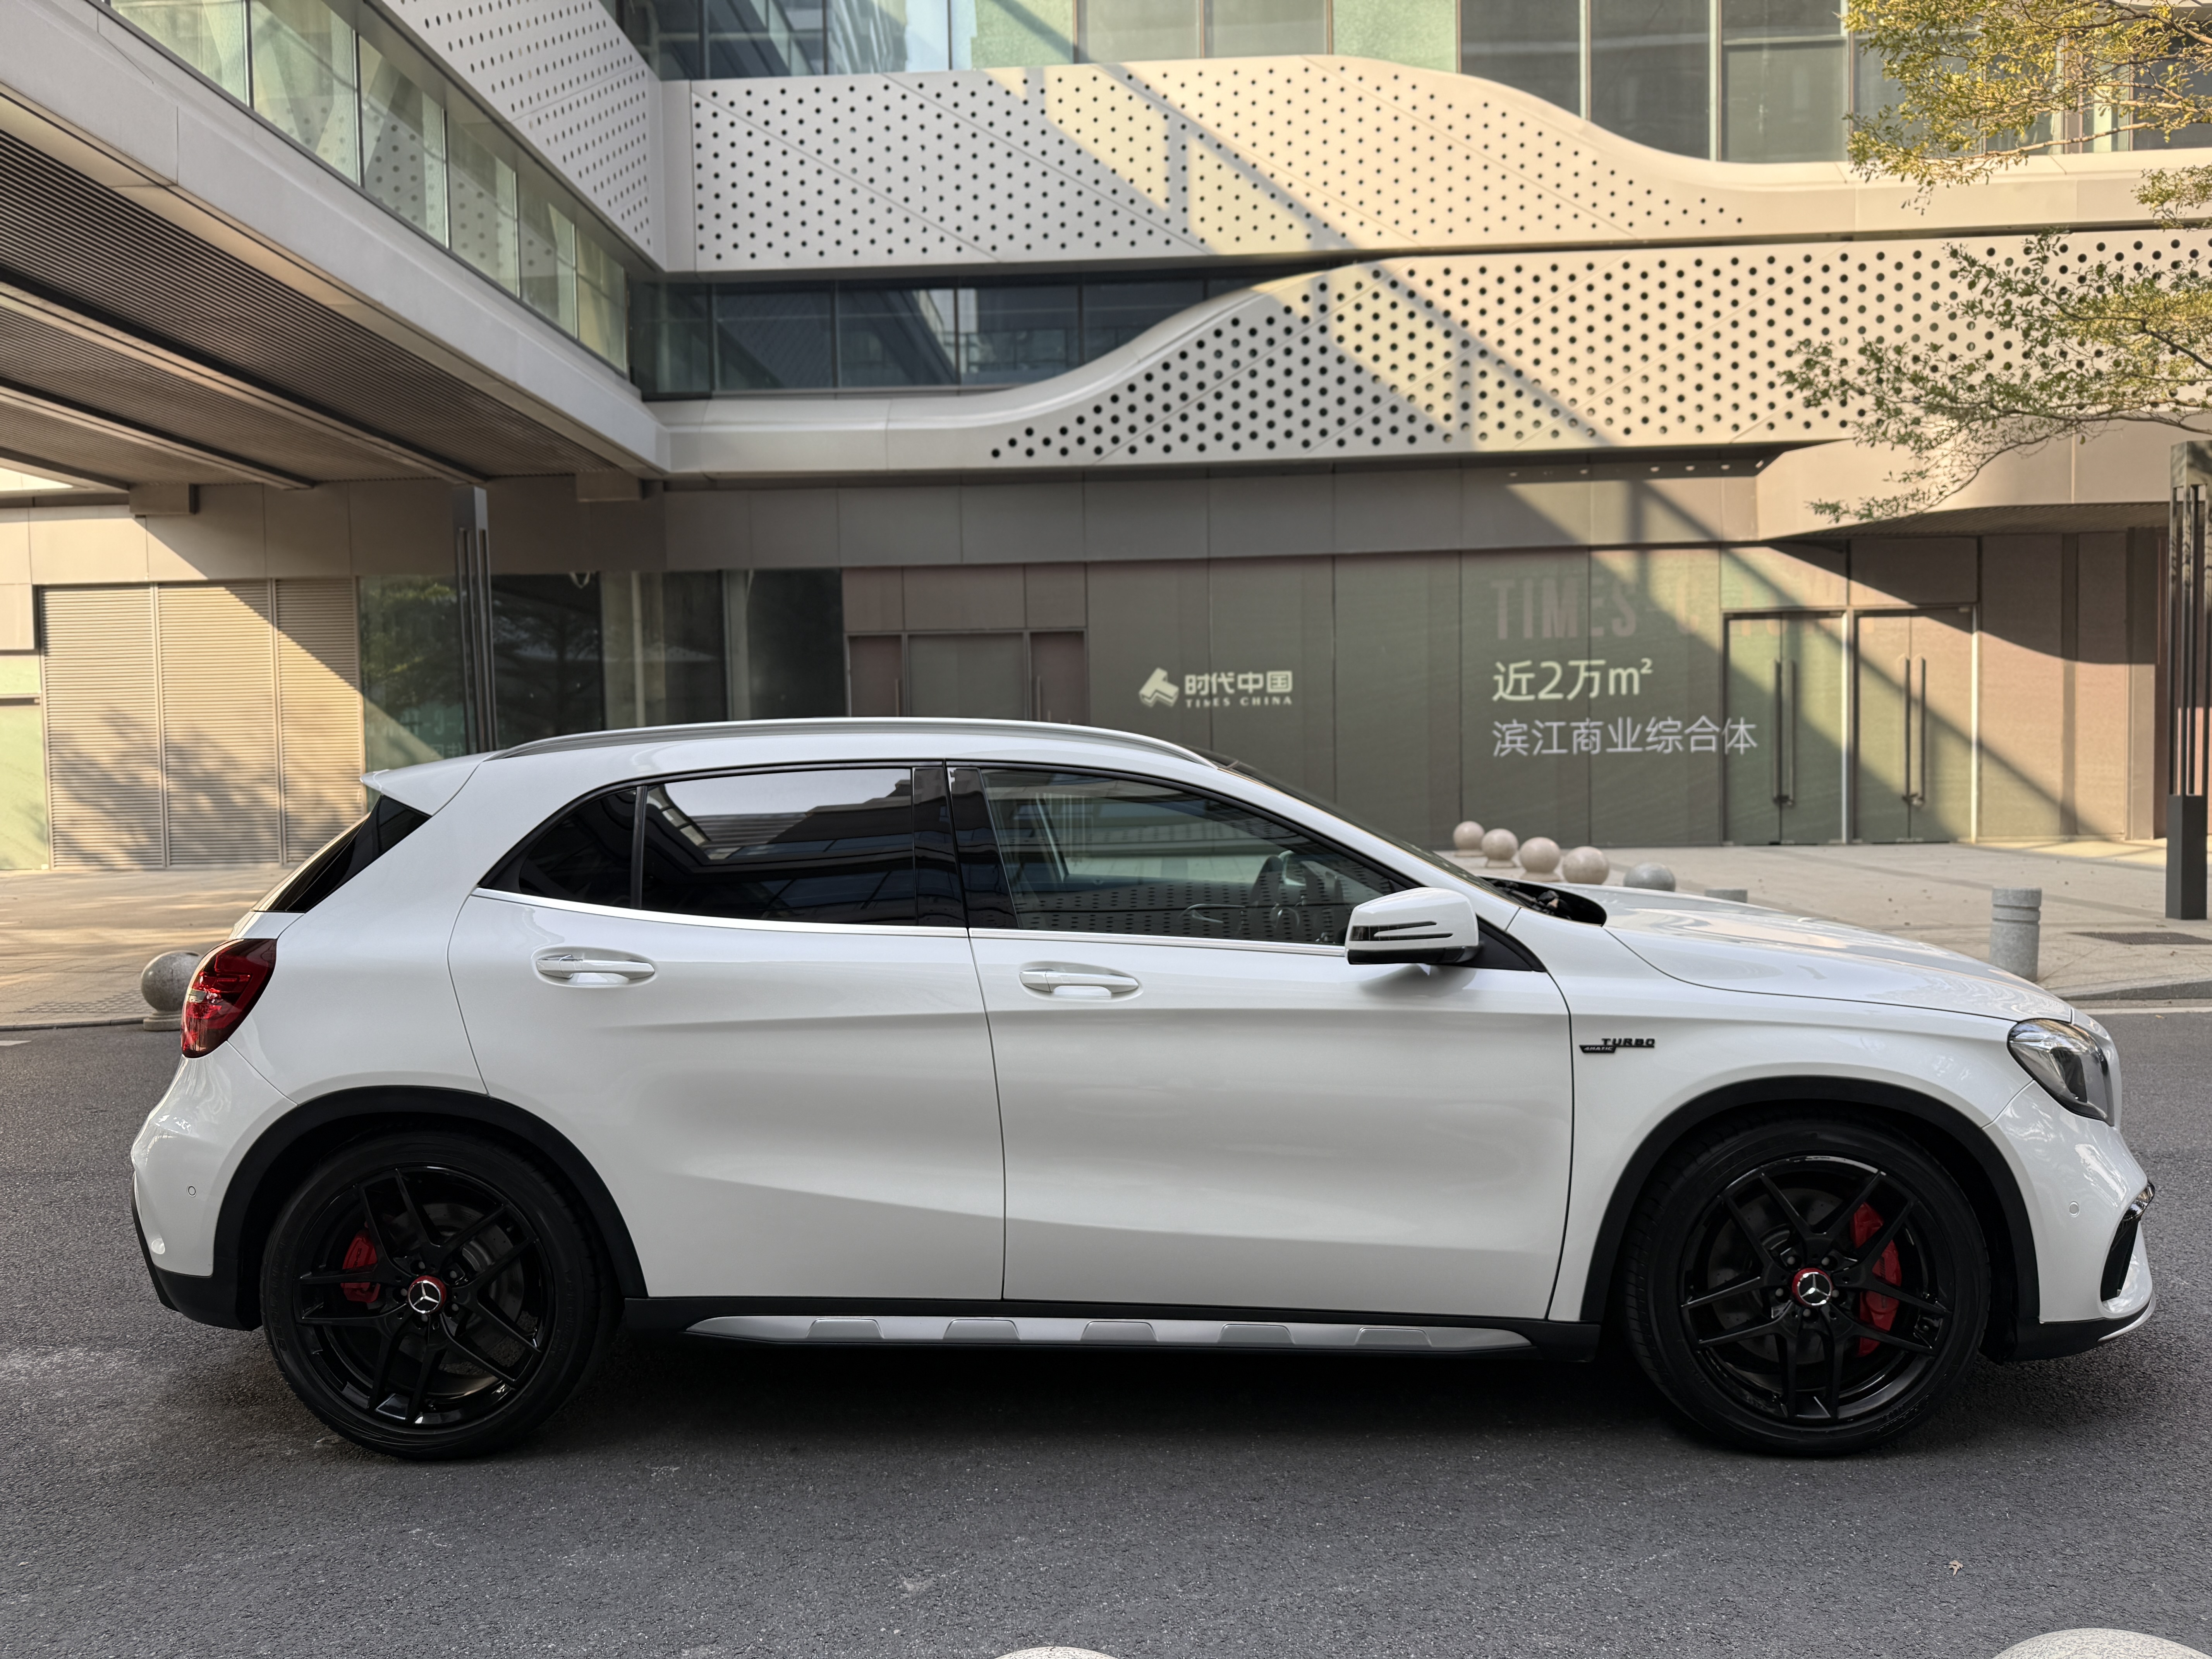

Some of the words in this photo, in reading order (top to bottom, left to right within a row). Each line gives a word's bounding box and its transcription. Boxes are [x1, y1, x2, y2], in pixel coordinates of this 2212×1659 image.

[1184, 670, 1293, 696] 时代中国
[1185, 698, 1231, 708] TIMES
[1240, 696, 1292, 706] CHINA
[1492, 715, 1758, 757] 滨江商业综合体
[1601, 1038, 1655, 1046] TURBO
